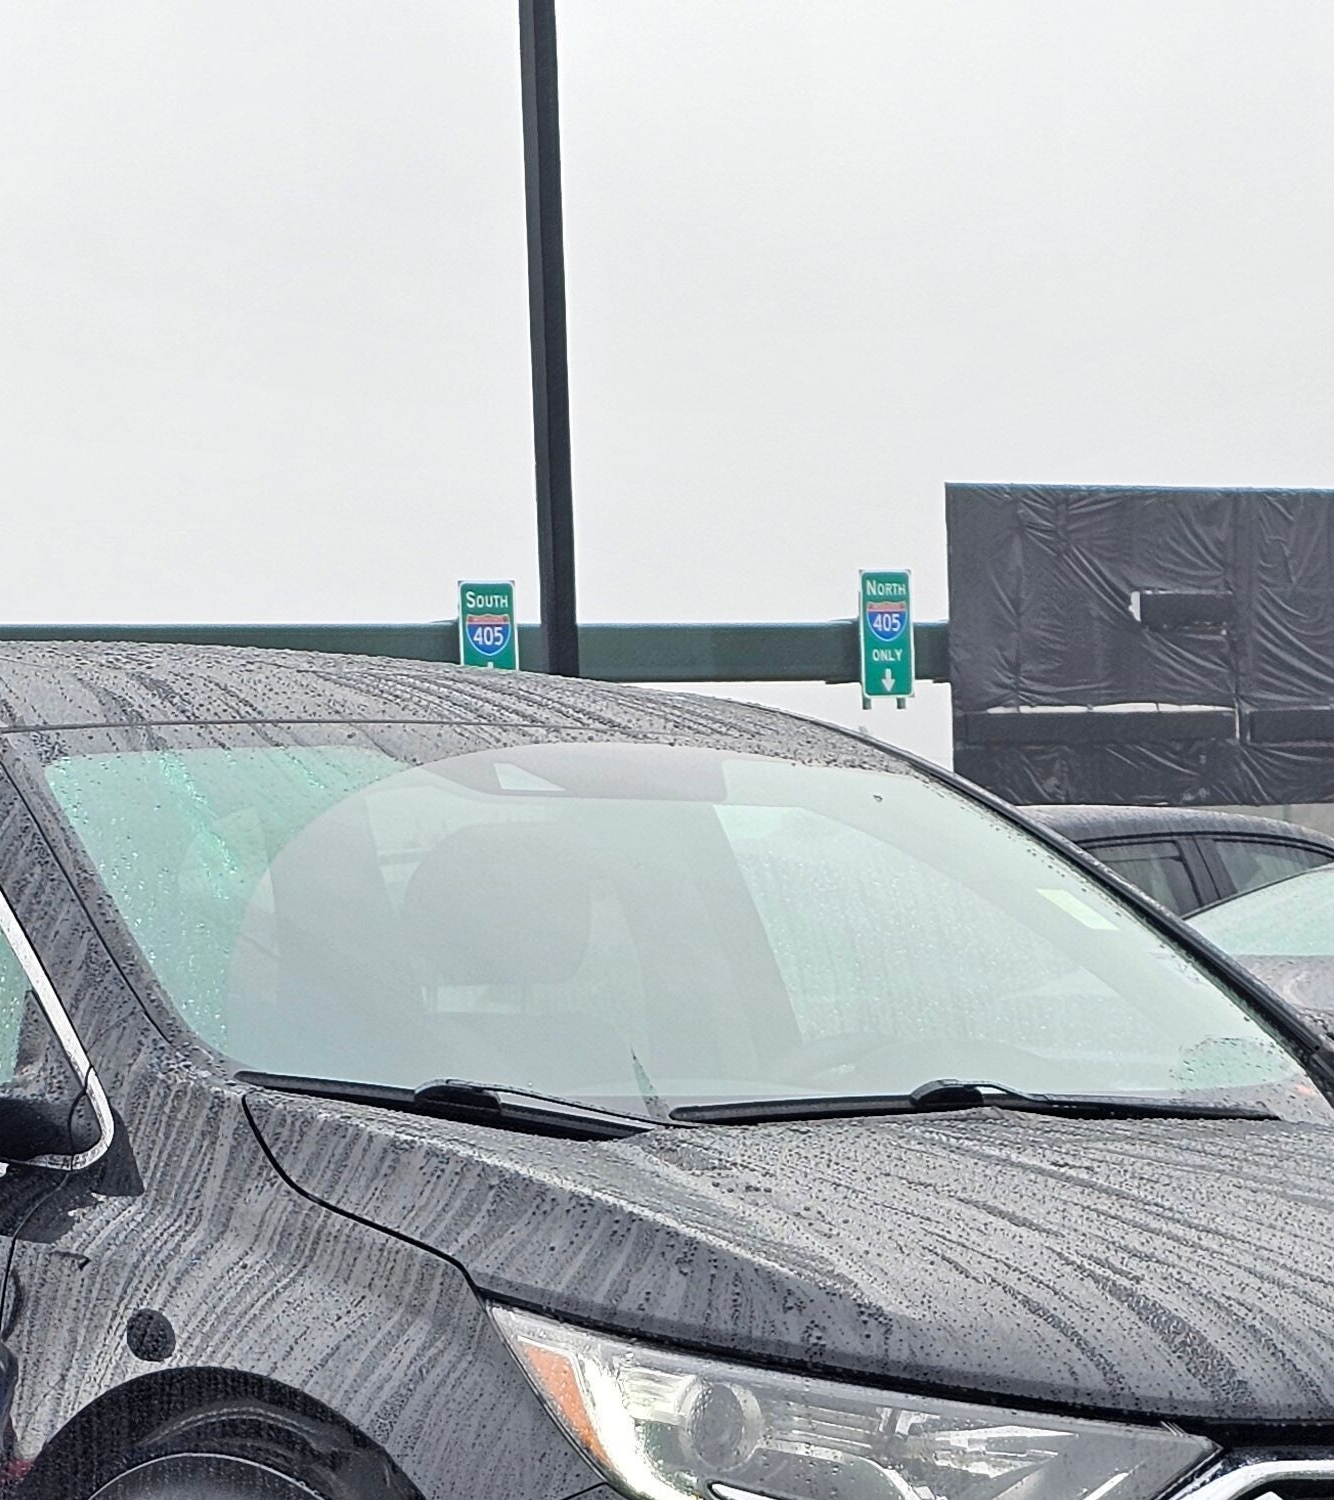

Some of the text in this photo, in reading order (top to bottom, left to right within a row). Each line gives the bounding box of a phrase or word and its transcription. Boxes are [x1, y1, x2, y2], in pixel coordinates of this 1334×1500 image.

[866, 580, 906, 596] NORTH
[466, 590, 508, 608] SOUTH
[873, 613, 901, 632] 405
[473, 626, 504, 646] 405
[872, 648, 903, 661] ONLY
